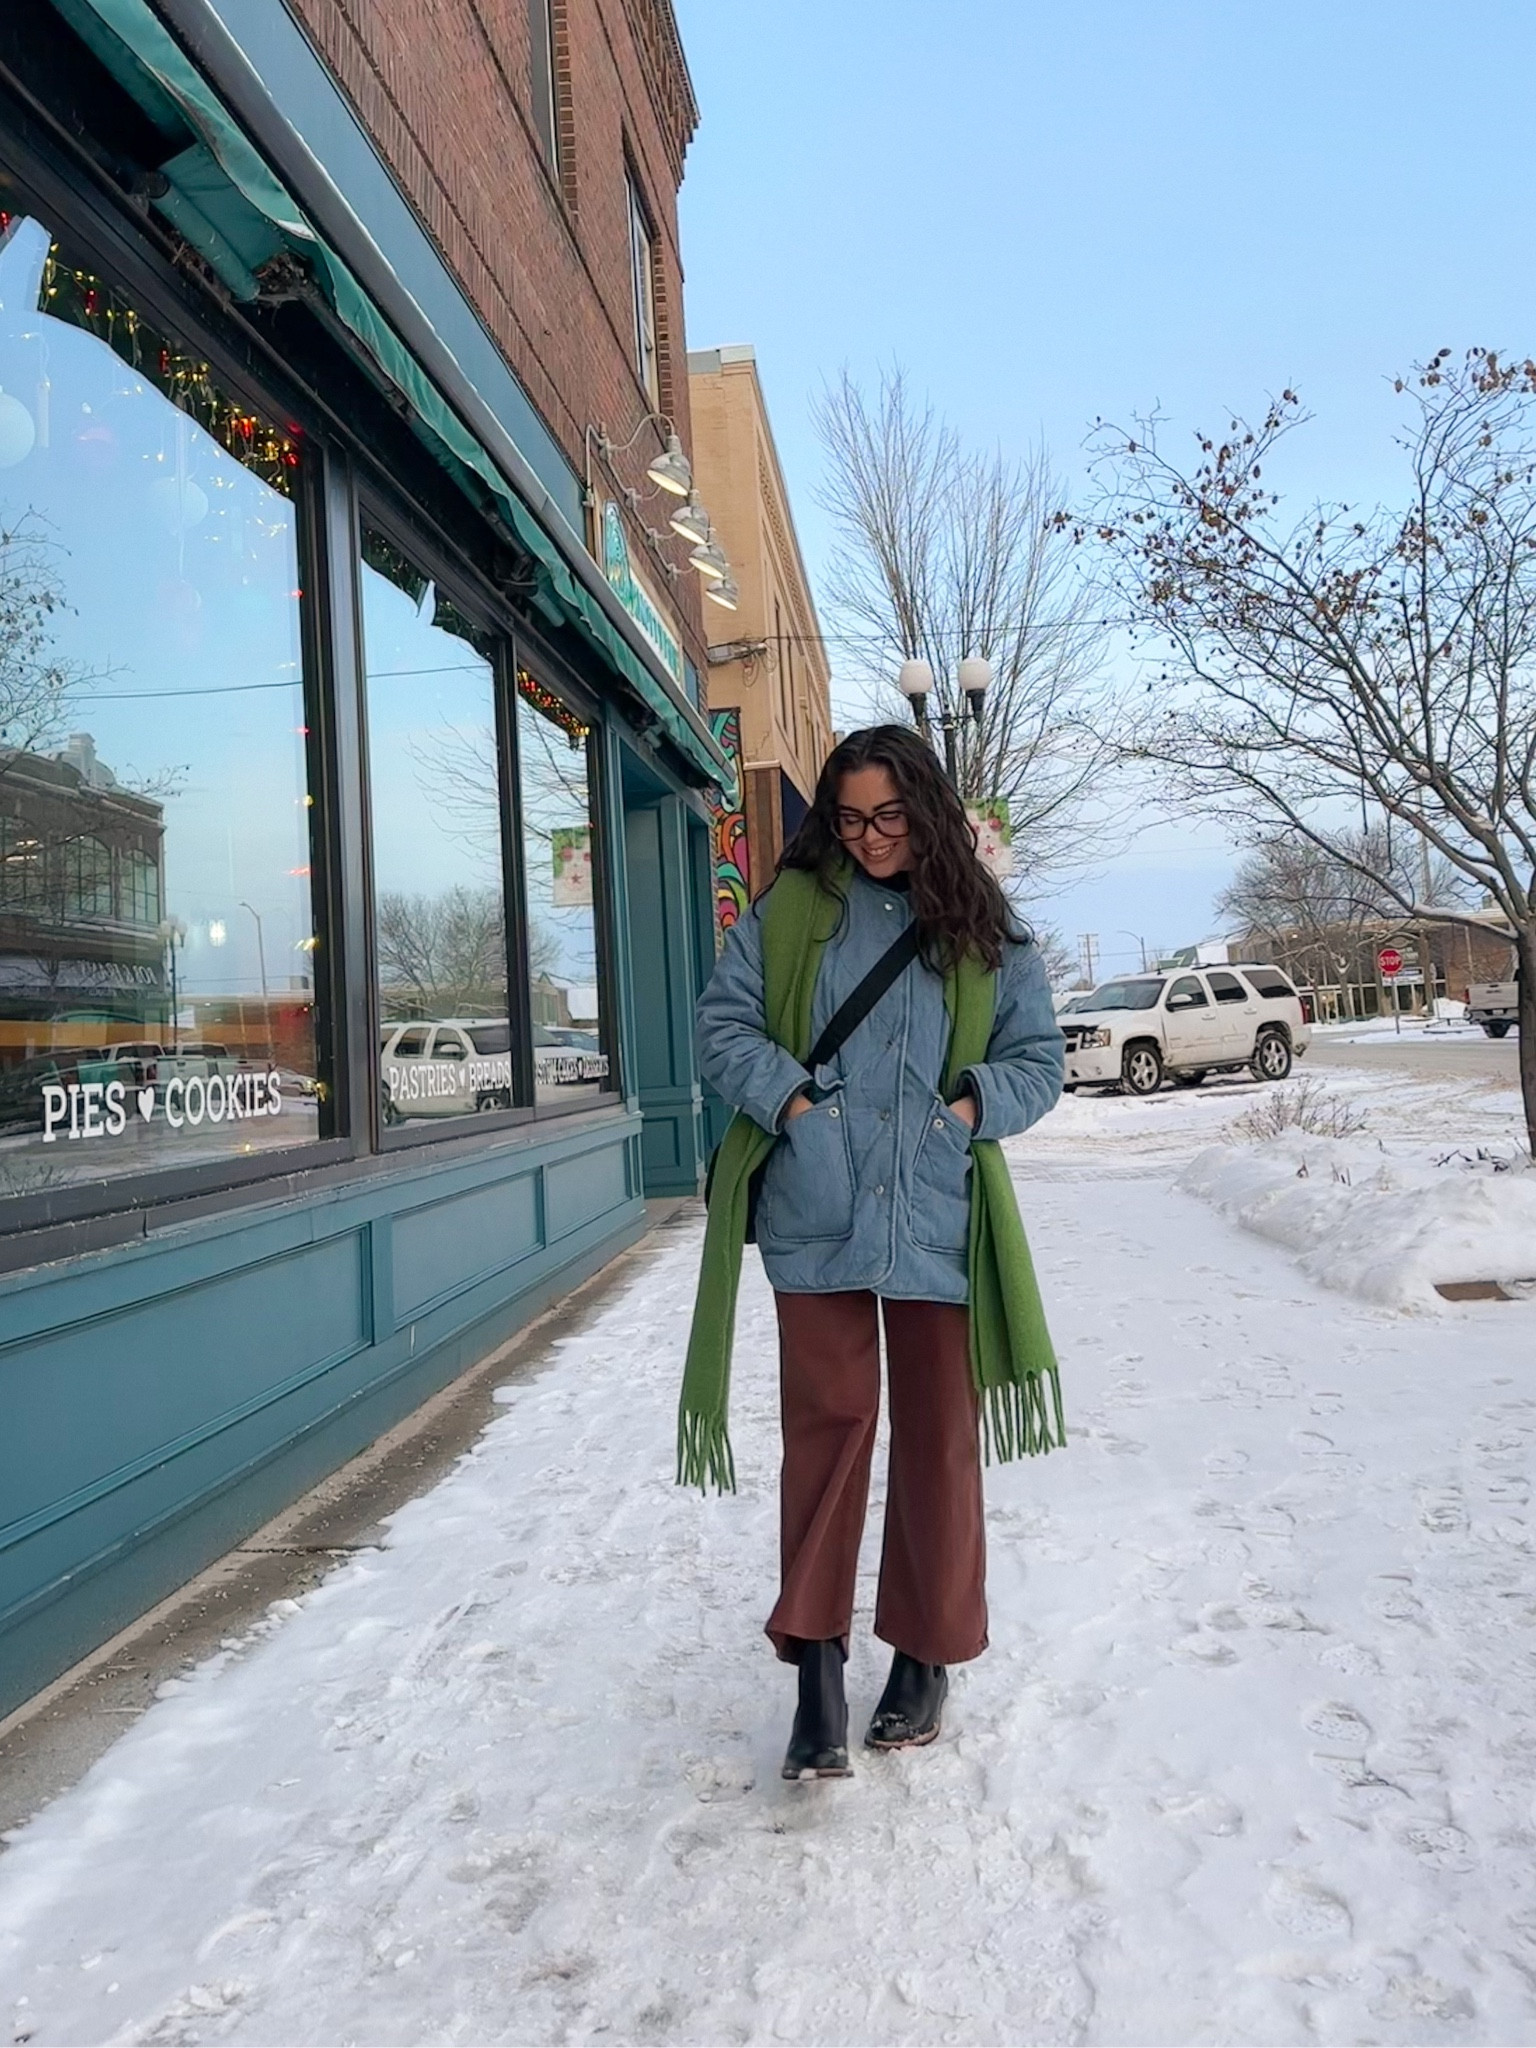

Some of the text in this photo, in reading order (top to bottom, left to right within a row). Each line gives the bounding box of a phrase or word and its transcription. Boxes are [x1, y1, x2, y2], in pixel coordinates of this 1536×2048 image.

[1380, 955, 1401, 967] STOP
[389, 1060, 511, 1101] PASTRIES BREADS
[42, 1071, 281, 1143] PIES COOKIES
